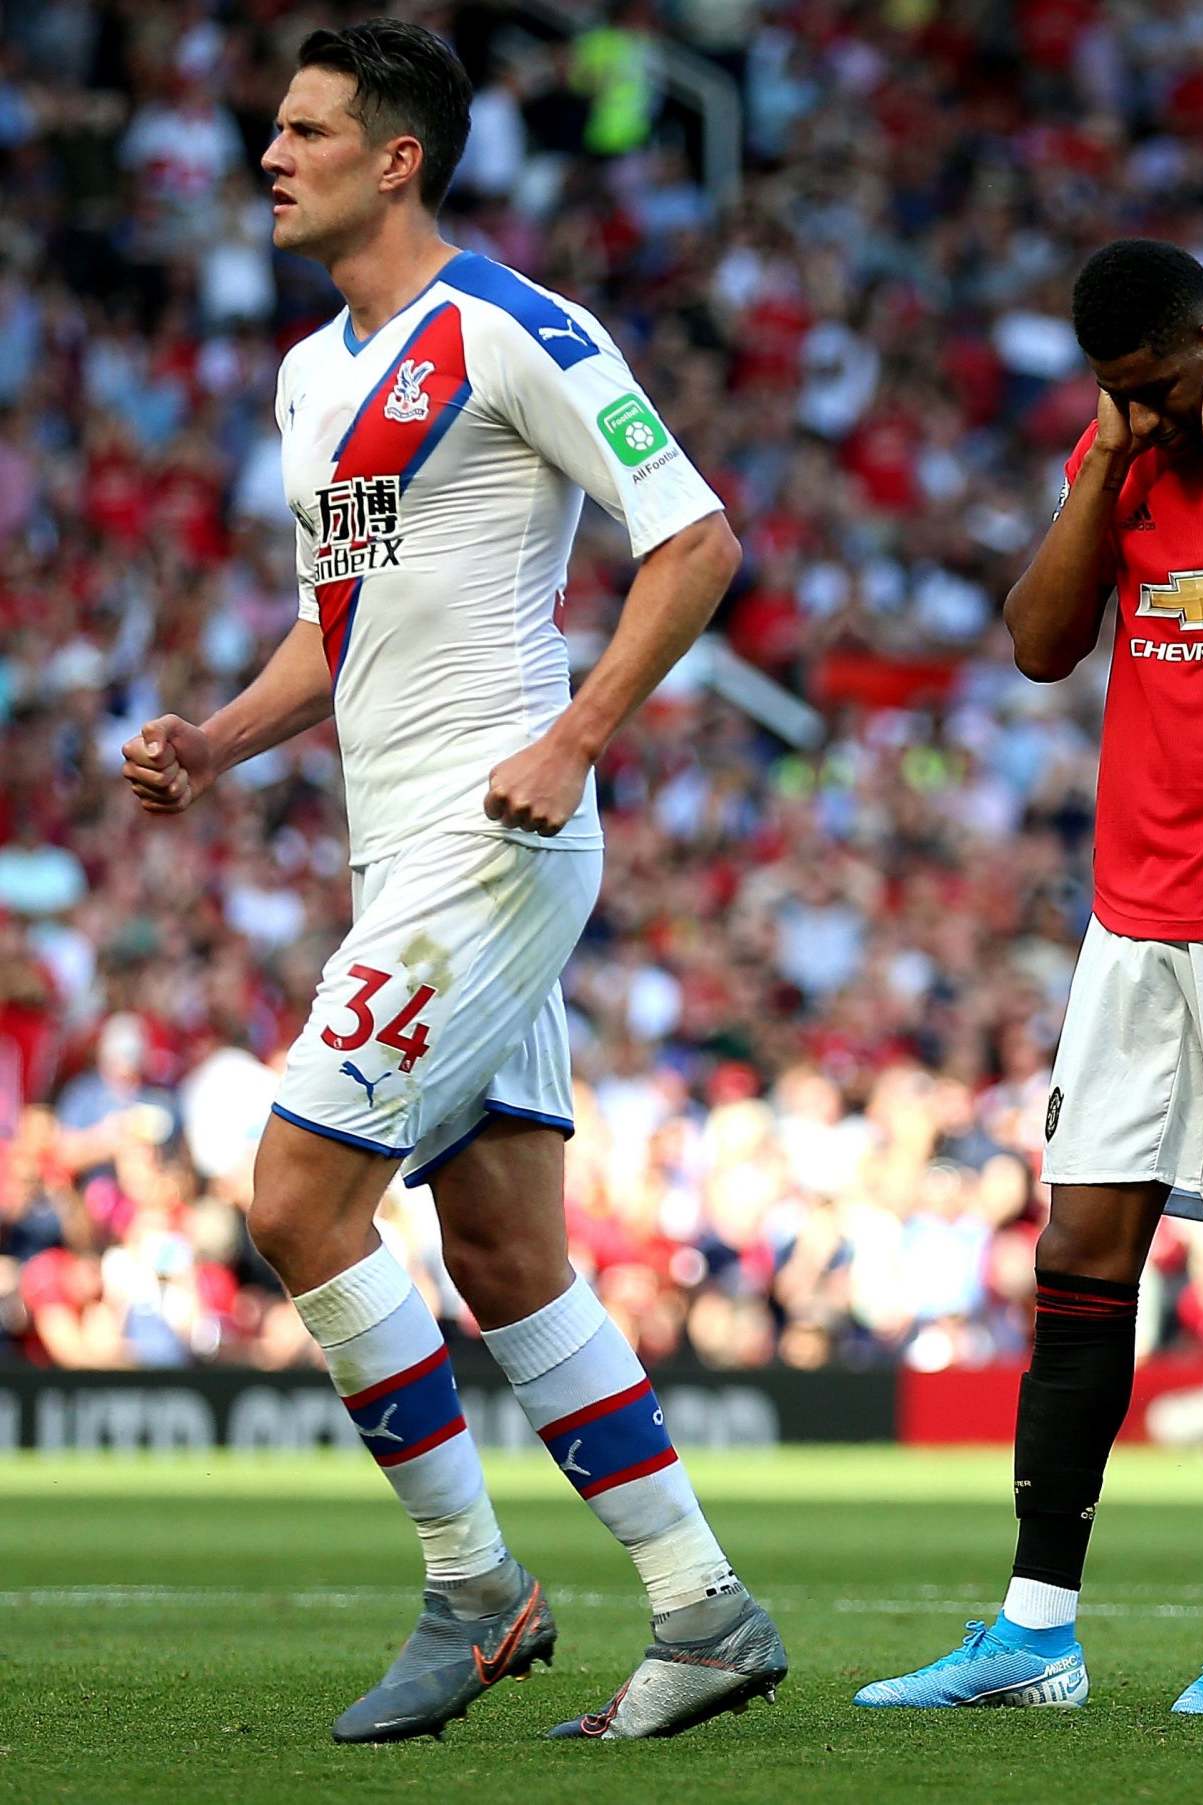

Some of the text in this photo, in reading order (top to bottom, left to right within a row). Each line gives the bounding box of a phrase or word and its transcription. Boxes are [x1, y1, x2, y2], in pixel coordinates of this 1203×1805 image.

[632, 468, 647, 485] All
[315, 479, 399, 543] 万博
[320, 963, 437, 1073] 34
